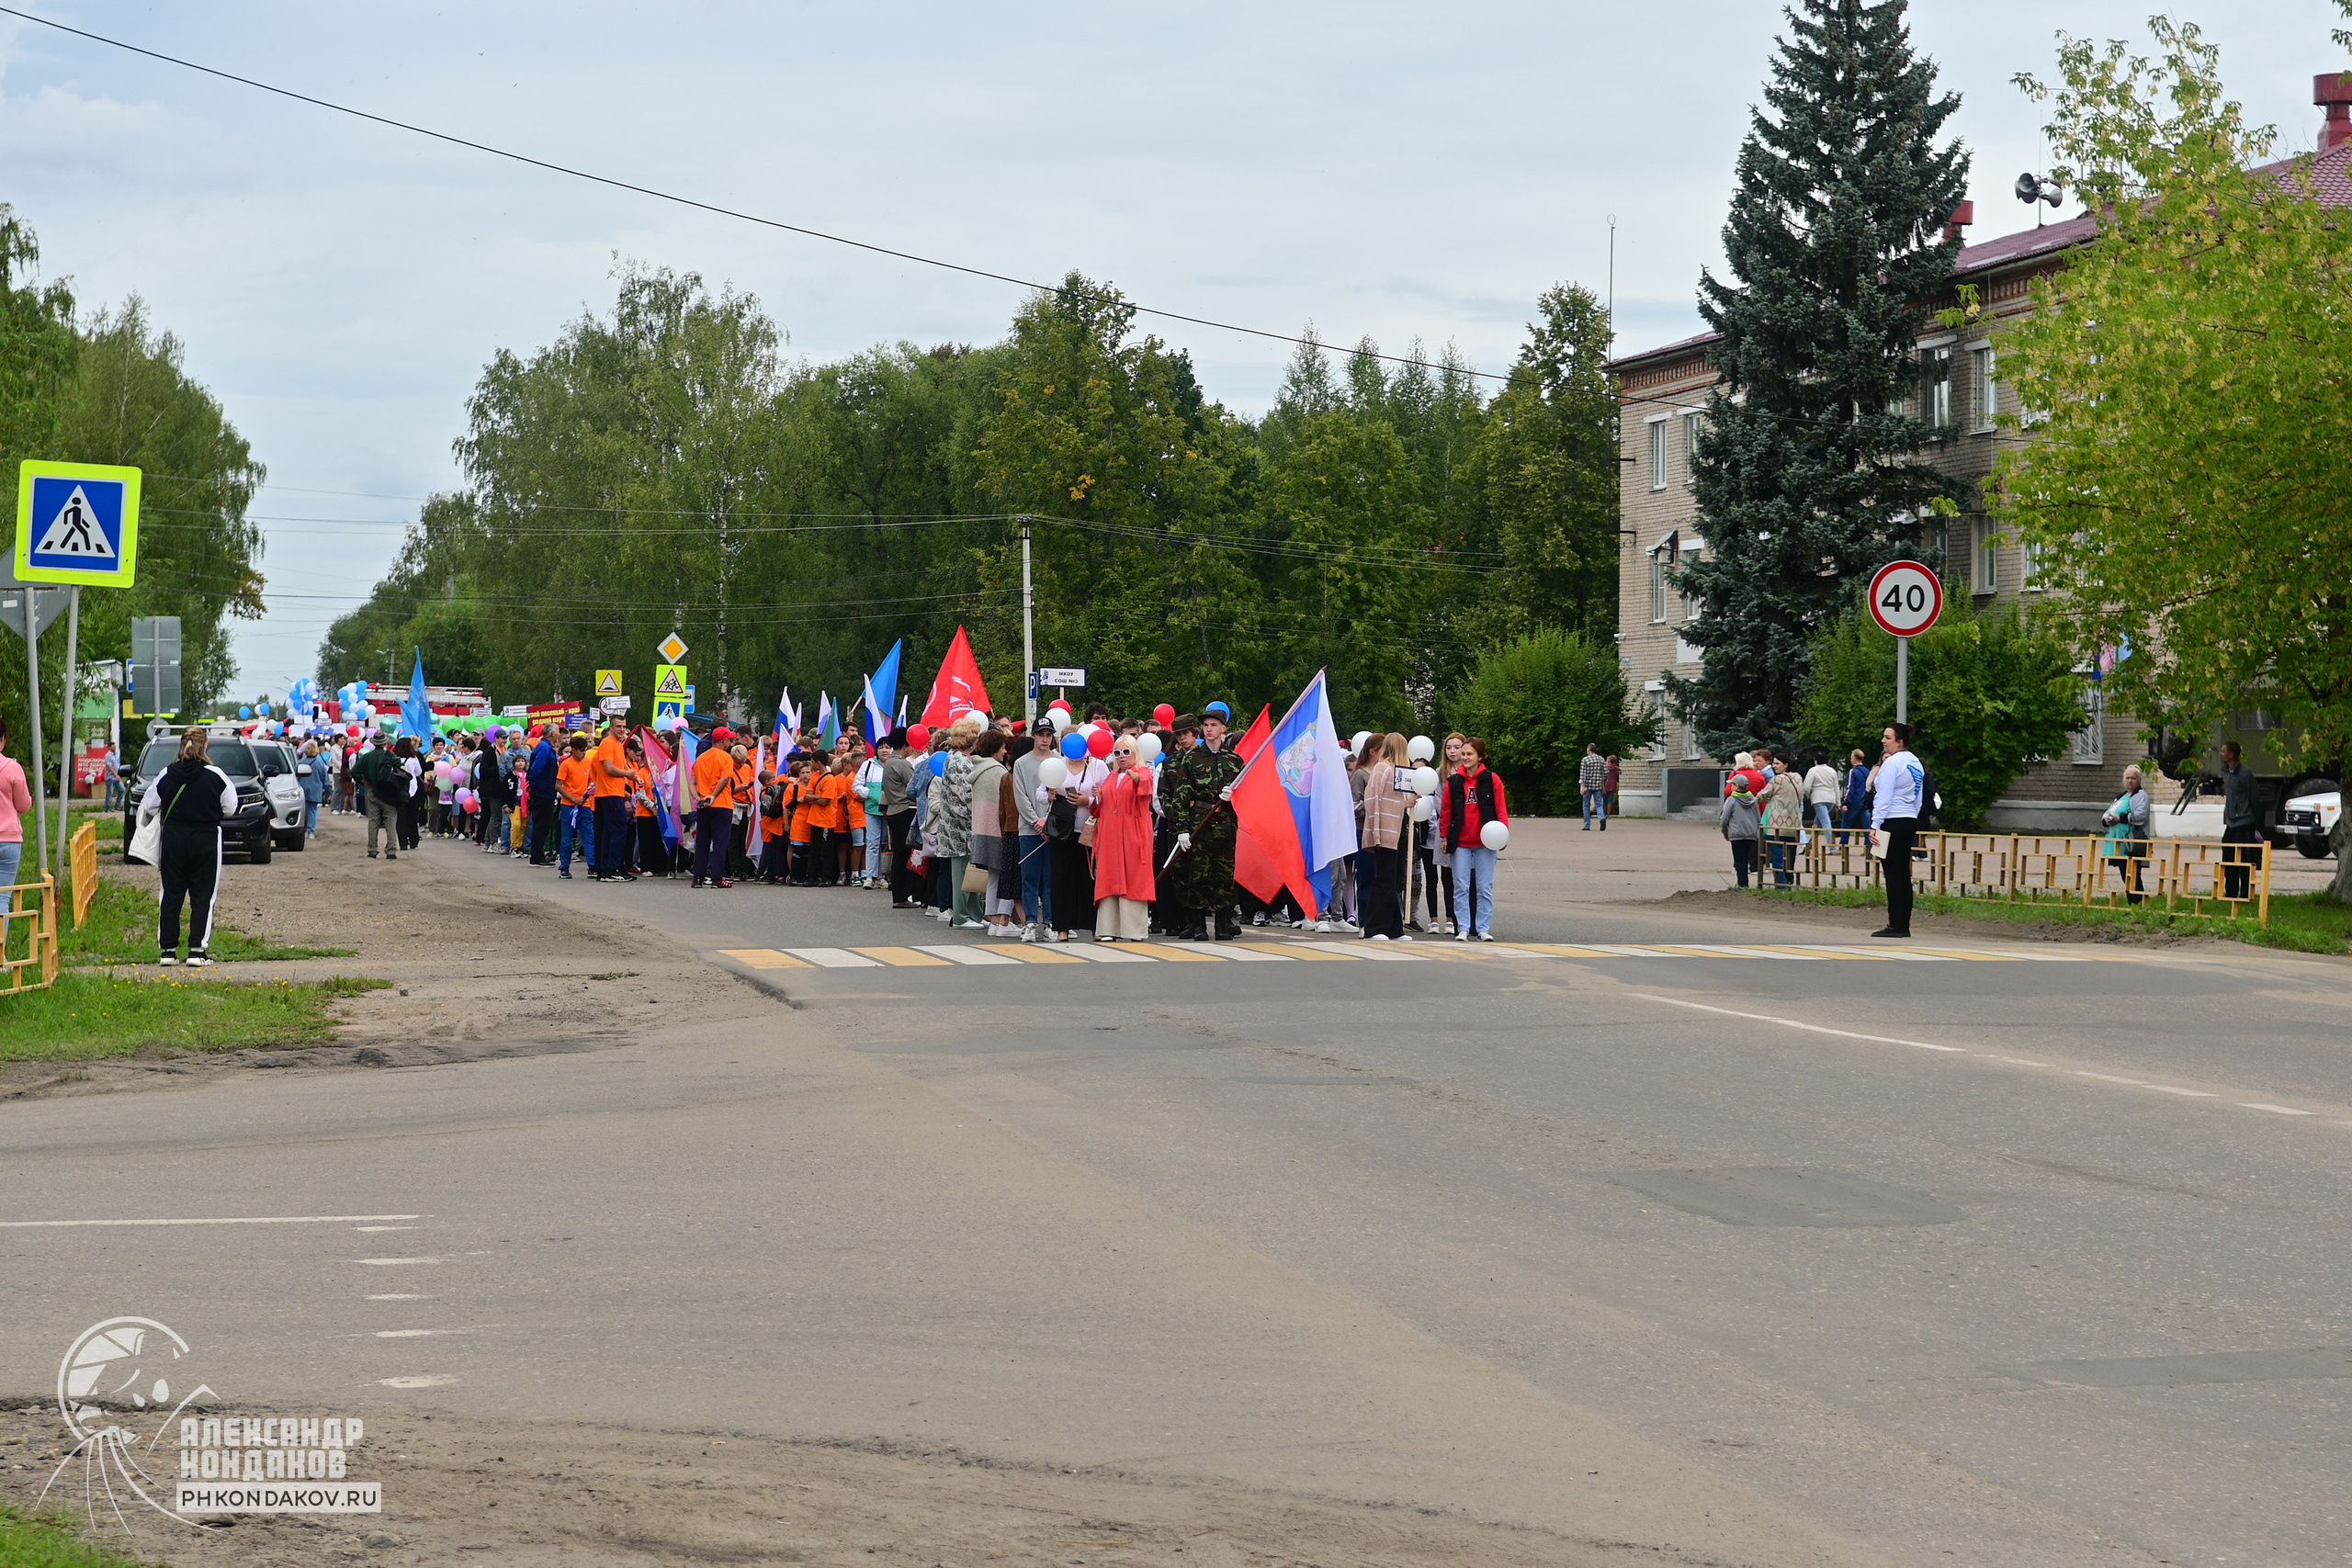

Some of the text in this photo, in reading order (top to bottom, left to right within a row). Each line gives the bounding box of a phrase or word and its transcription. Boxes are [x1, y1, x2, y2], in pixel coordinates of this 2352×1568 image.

[1882, 584, 1925, 613] 40
[1030, 675, 1036, 697] P
[1465, 787, 1478, 804] A
